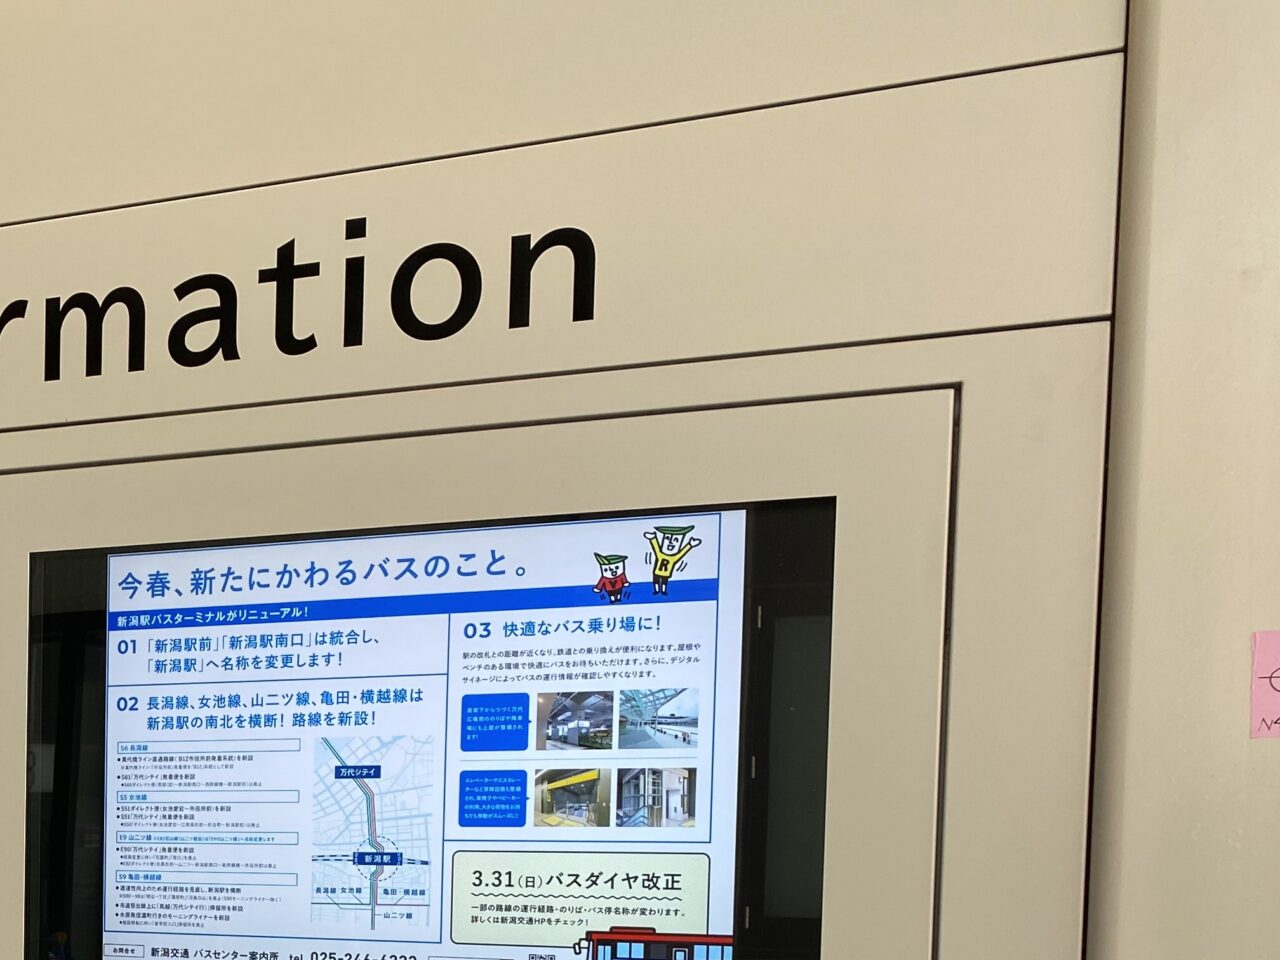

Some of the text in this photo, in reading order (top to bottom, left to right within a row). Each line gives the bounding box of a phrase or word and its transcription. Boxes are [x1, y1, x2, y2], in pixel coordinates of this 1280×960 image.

[118, 549, 526, 600] 今春、新たにかわるバスのこと。
[117, 607, 309, 627] 新潟駅バスターミナルがリニューアル！
[463, 616, 661, 639] 03 快適なバス乗り場に！
[117, 630, 380, 655] 01 「新潟駅前」「新潟駅南口」は統合し、
[462, 643, 702, 660] 駅の改札との距離が近くなり、鉄道との乗り換えが便利になります。屋根や
[147, 653, 343, 674] 「新潟駅」へ名称を変更します！
[462, 656, 701, 672] ベンチのある環境で快適にバスをお待ちいただけます。さらに、デジタル
[462, 670, 656, 684] サイネージによってバスの運行情報が確認しやすくなります。
[116, 688, 424, 712] 02 長潟線、女池線、山二ツ線、亀田・横越線は
[340, 768, 376, 776] 万代シテイ
[364, 855, 391, 863] 新潟駅
[472, 870, 682, 891] 3.31（日）バスダイヤ改正
[382, 888, 426, 896] 亀田・横越線
[471, 904, 686, 917] 一部の路線の運行経路・のりば・バス停名称が変わります。
[470, 916, 589, 927] 詳しくは新潟交通HPをチェック！
[151, 947, 189, 959] 新潟交通
